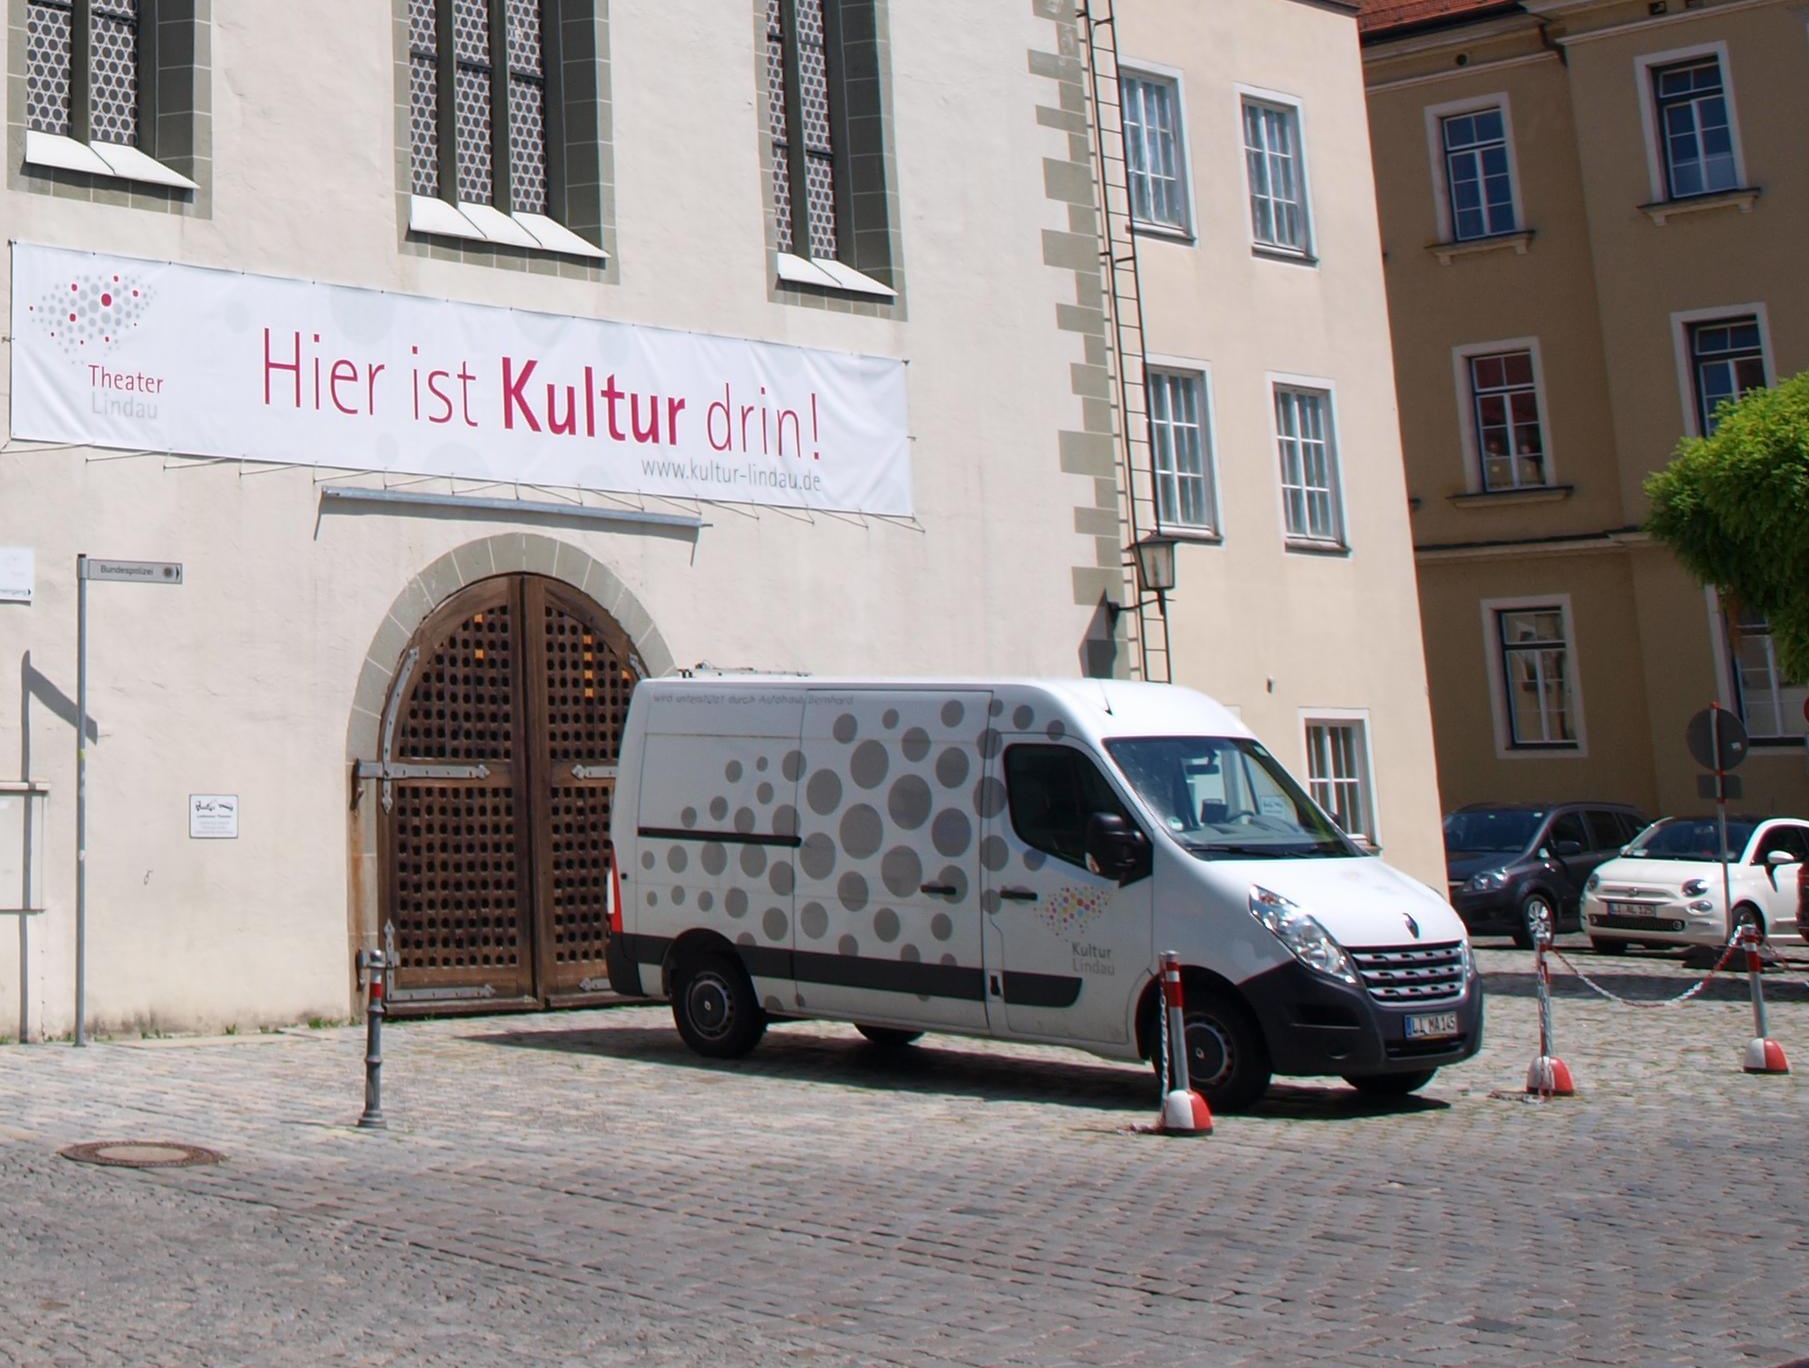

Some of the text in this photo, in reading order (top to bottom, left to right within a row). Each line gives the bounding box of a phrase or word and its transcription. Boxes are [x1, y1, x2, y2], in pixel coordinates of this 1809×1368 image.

[88, 364, 163, 393] Theater
[91, 391, 158, 419] Lindau
[264, 327, 820, 461] Hier ist Kultur drin!
[641, 458, 822, 492] www.kultur-lindau.de
[100, 564, 154, 576] Bundespolizei
[728, 695, 755, 705] durch
[1072, 942, 1111, 959] Kultur
[1072, 958, 1115, 976] Lindau
